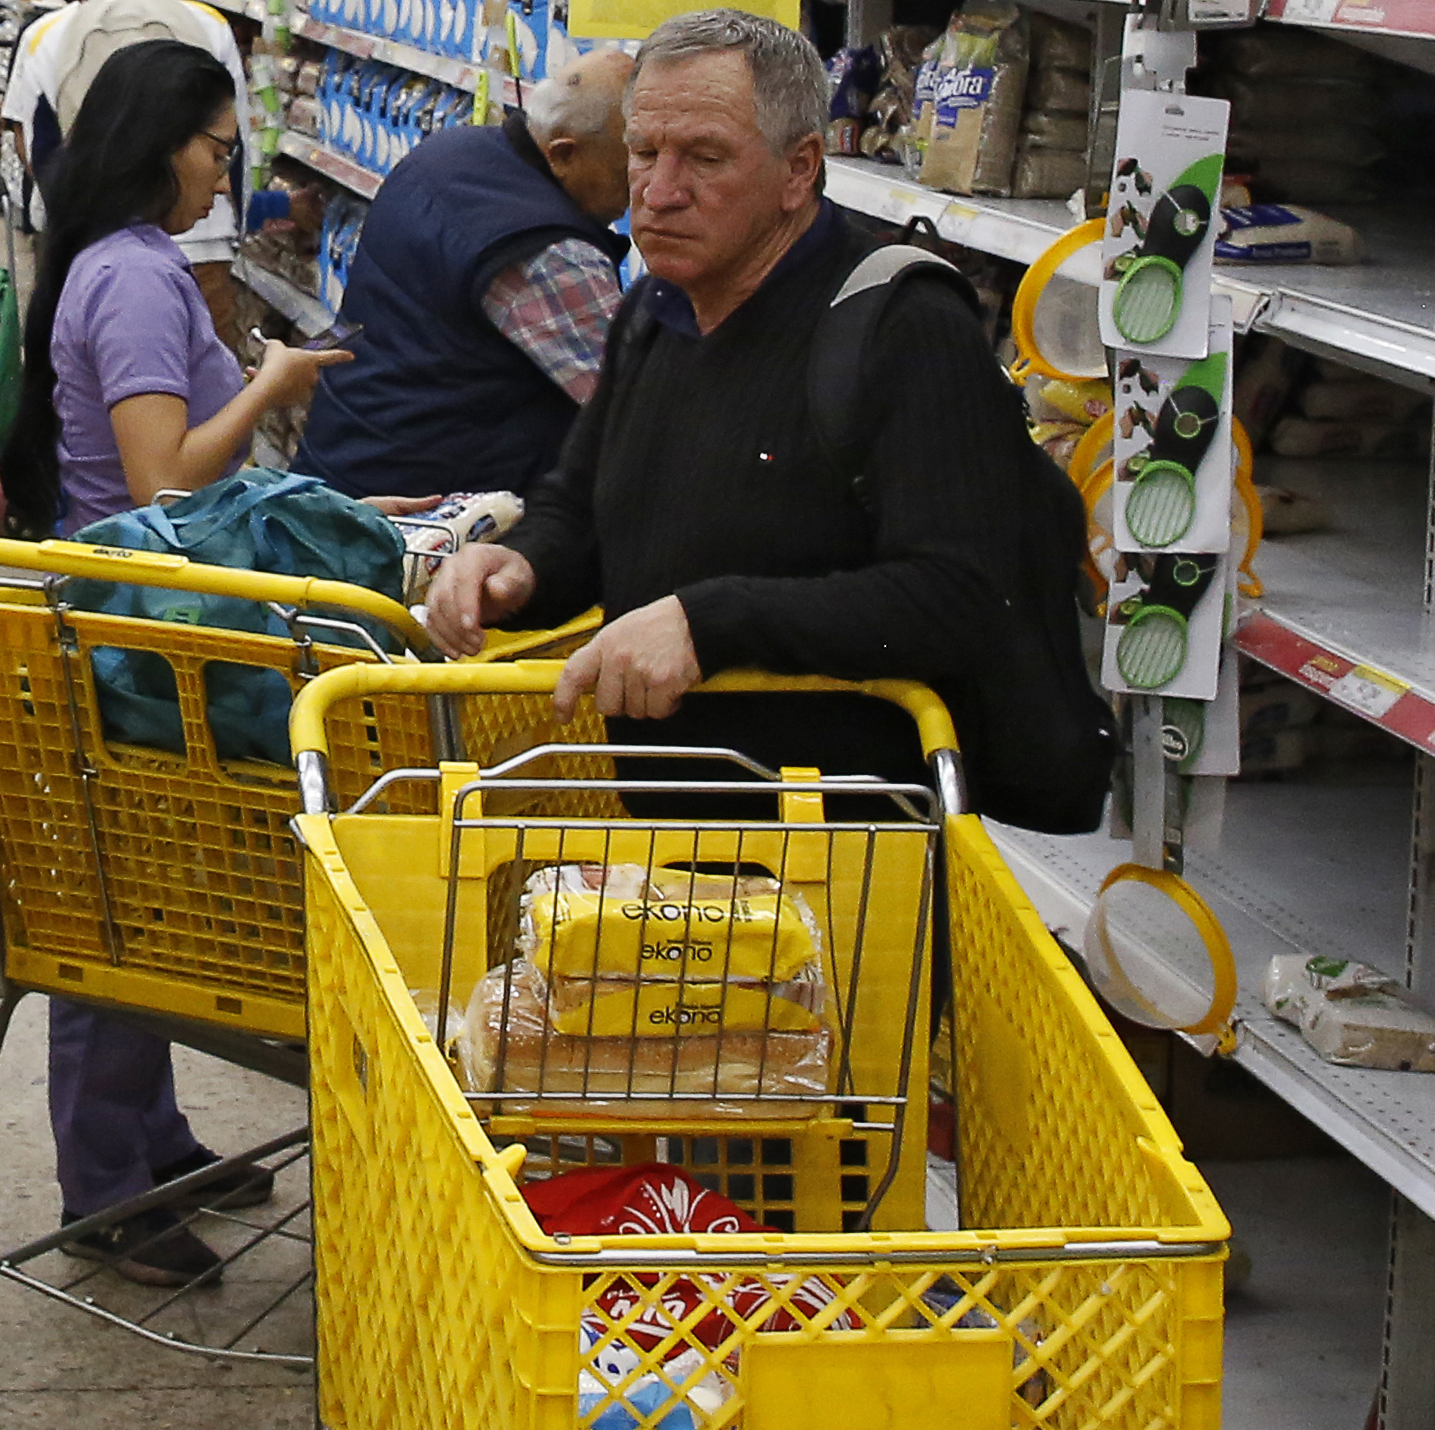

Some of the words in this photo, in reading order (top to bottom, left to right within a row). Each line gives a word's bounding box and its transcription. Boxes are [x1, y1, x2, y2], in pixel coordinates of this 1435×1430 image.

[621, 903, 725, 923] ekono
[640, 940, 713, 962] ekono
[649, 1004, 722, 1025] ekono
